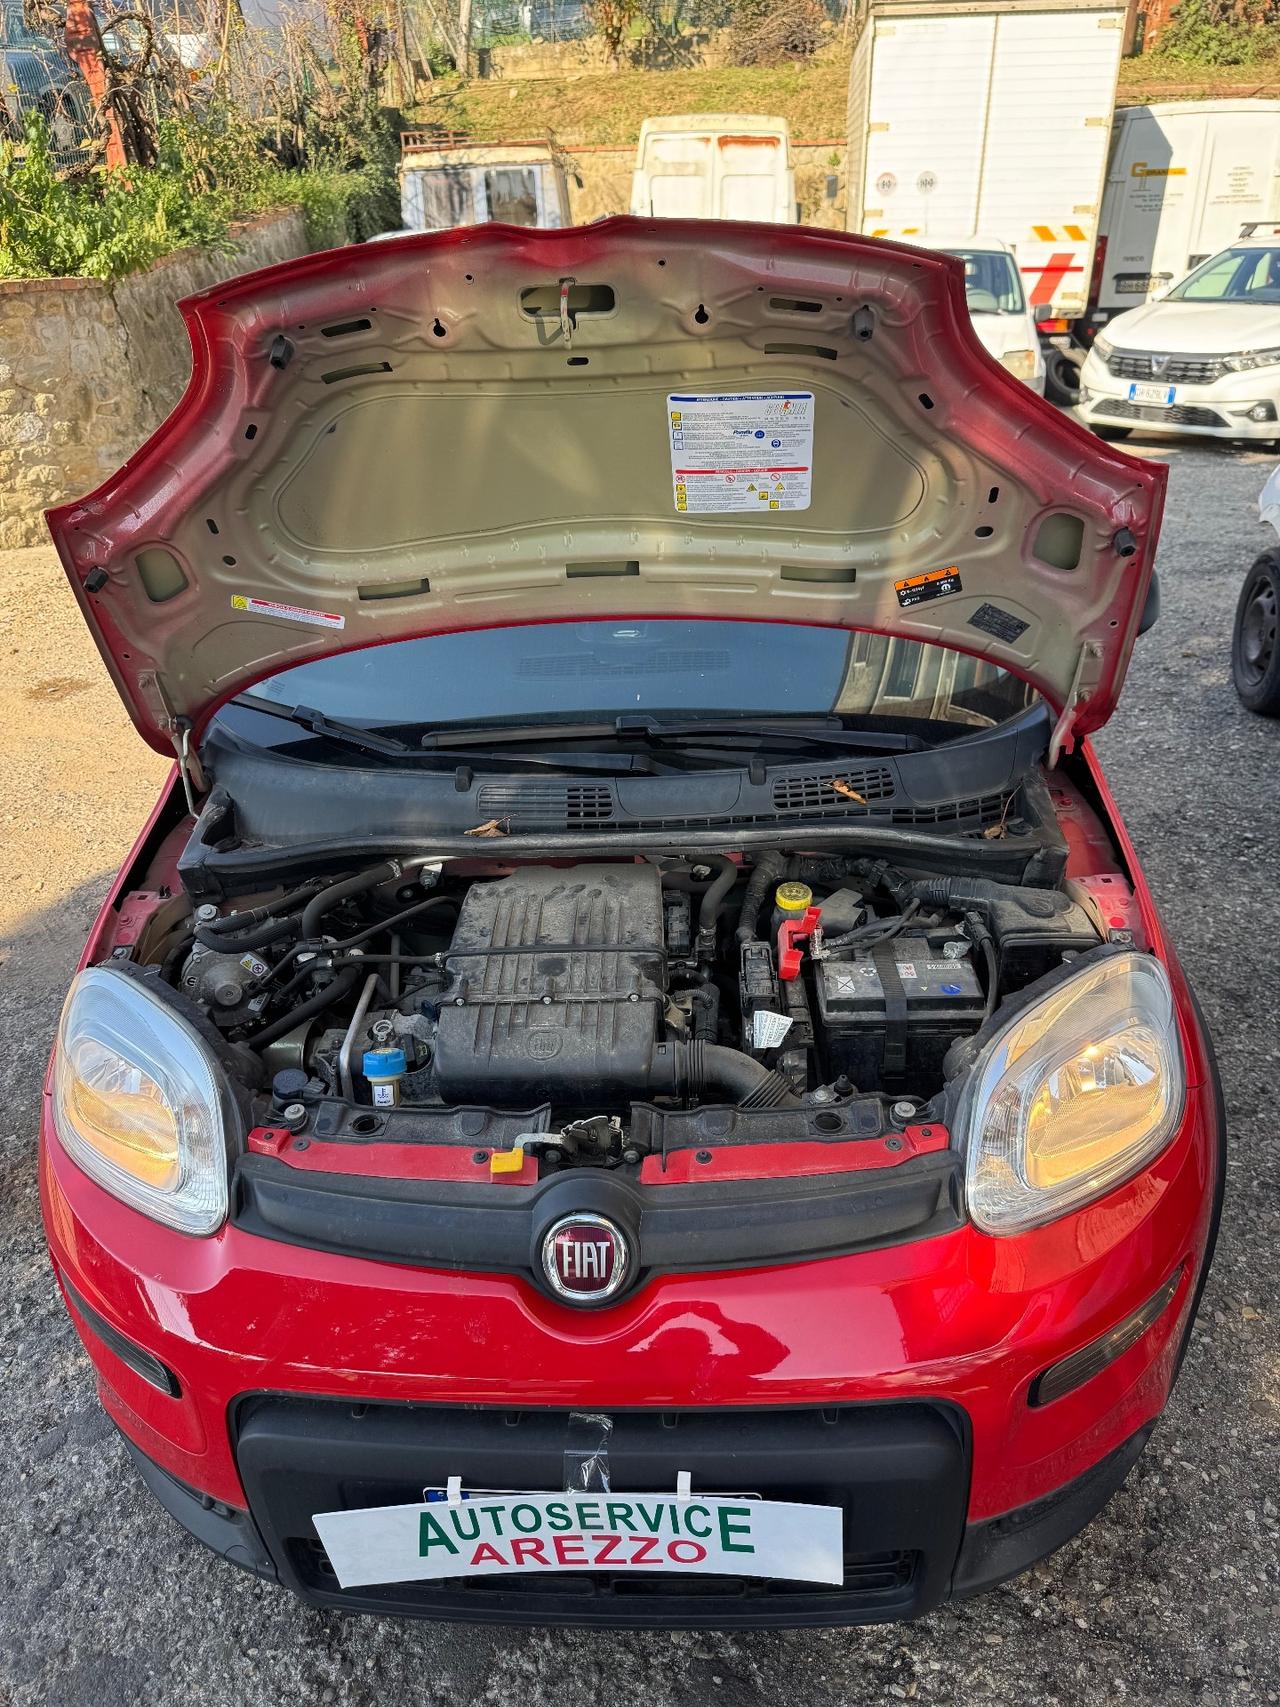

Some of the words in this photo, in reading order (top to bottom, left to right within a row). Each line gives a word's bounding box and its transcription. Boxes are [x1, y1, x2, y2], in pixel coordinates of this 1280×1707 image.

[562, 1241, 611, 1278] FIAT
[418, 1502, 756, 1557] AUTOSERVICE
[469, 1534, 708, 1566] AREZZO
